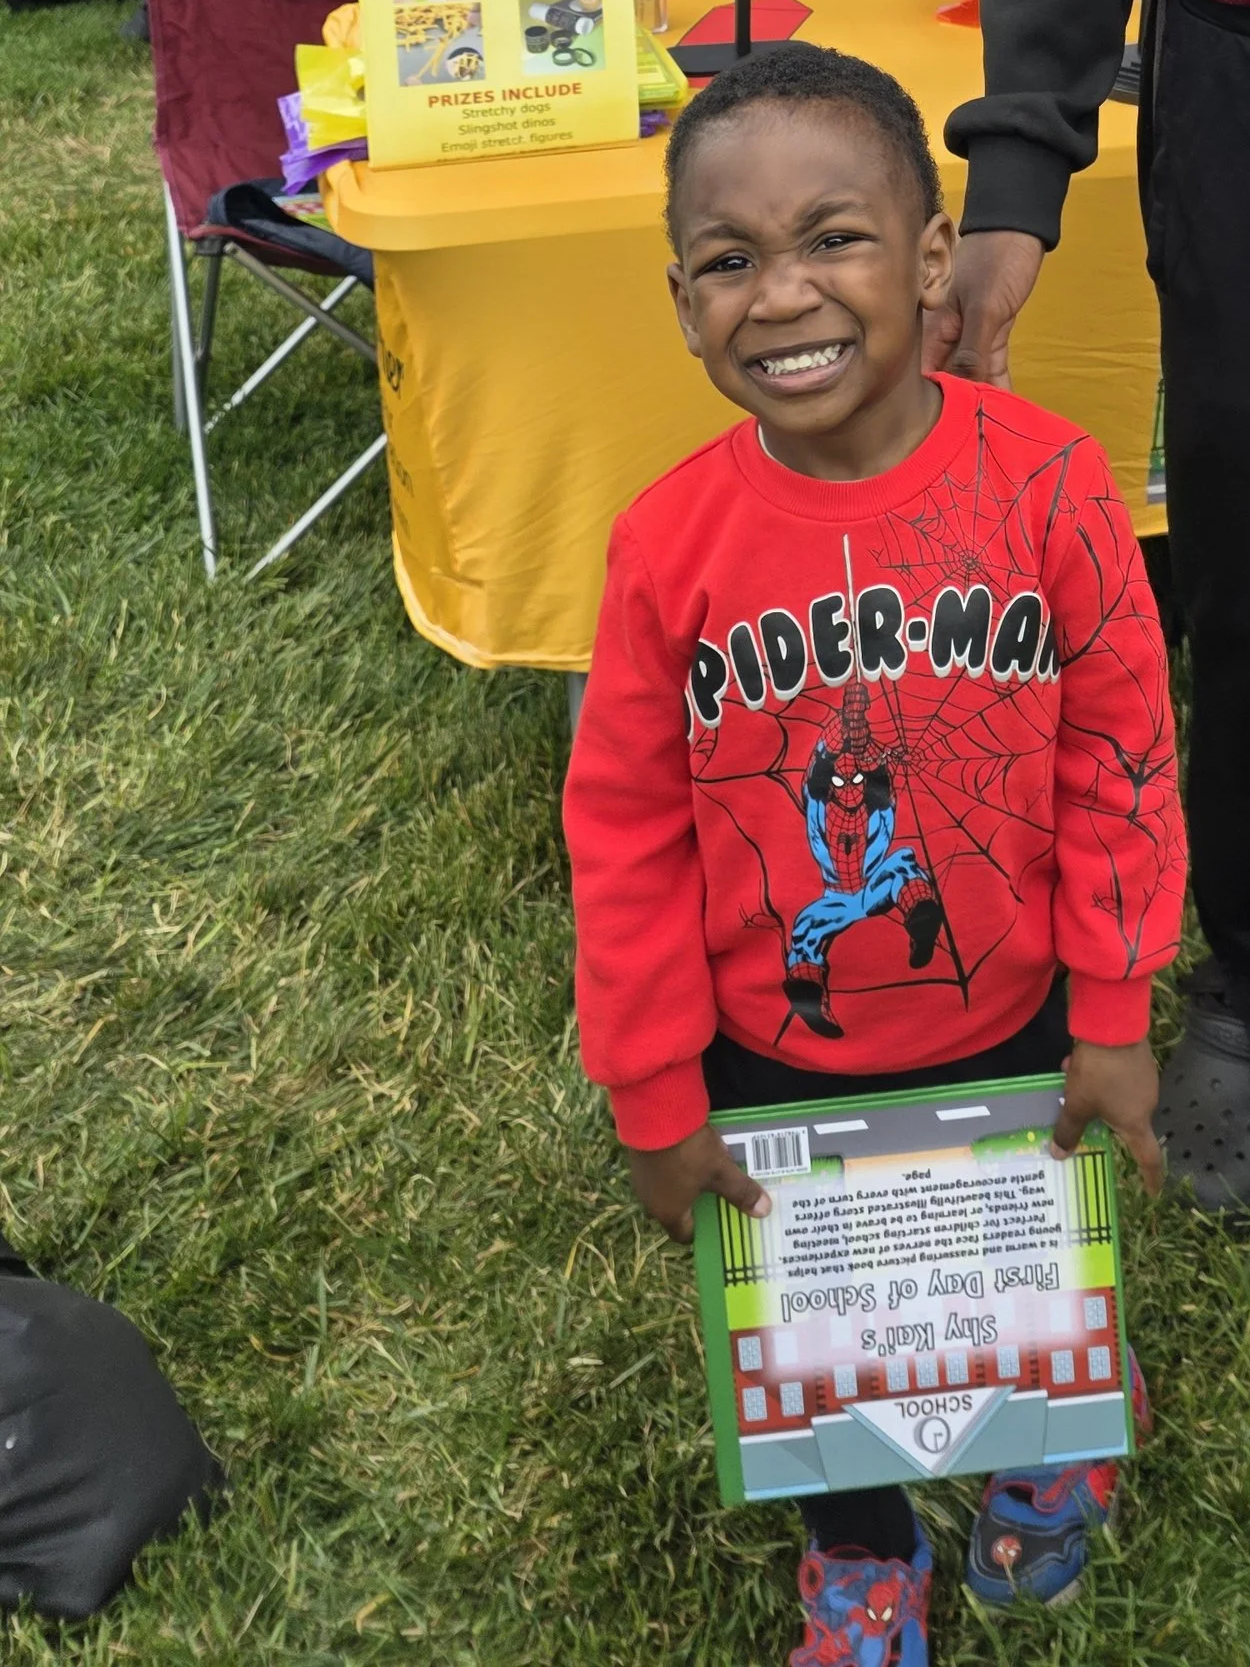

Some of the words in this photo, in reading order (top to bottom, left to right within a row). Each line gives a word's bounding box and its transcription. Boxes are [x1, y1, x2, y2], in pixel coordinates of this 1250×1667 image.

[427, 90, 496, 109] PRIZES
[502, 82, 583, 102] INCLUDE
[461, 104, 518, 121] Stretchy
[520, 101, 552, 116] dogs
[457, 118, 520, 137] Slingshot
[522, 115, 556, 129] dinos
[440, 137, 478, 155] Emoji
[529, 129, 574, 145] figures
[683, 583, 1061, 741] PIDER-MA
[902, 1168, 931, 1181] page.
[1010, 1170, 1045, 1185] gentle
[920, 1177, 1007, 1193] encouragement
[1019, 1185, 1045, 1195] way.
[829, 1194, 853, 1203] turn
[856, 1190, 888, 1200] every
[892, 1187, 917, 1198] with
[994, 1190, 1016, 1200] This
[792, 1199, 811, 1209] the
[814, 1198, 826, 1208] of
[930, 1192, 991, 1207] beautifully
[1032, 1199, 1054, 1207] new
[833, 1206, 864, 1217] story
[868, 1199, 927, 1215] illustrated
[970, 1207, 983, 1215] or
[985, 1202, 1028, 1214] friends,
[795, 1211, 830, 1221] offers
[890, 1215, 903, 1224] be
[906, 1214, 918, 1222] to
[921, 1208, 967, 1221] learning
[1003, 1213, 1045, 1226] Perfect
[842, 1222, 852, 1231] in
[856, 1217, 887, 1228] brave
[934, 1221, 980, 1233] children
[983, 1219, 1000, 1228] for
[785, 1227, 808, 1236] own
[811, 1224, 839, 1234] their
[883, 1226, 931, 1239] starting
[983, 1229, 1026, 1241] readers
[1029, 1223, 1062, 1235] young
[793, 1238, 839, 1250] meeting
[841, 1232, 880, 1246] school,
[934, 1238, 953, 1247] the
[956, 1234, 979, 1244] face
[1049, 1240, 1058, 1248] is
[852, 1247, 875, 1255] new
[878, 1245, 890, 1255] of
[893, 1240, 931, 1251] nerves
[982, 1246, 1002, 1256] and
[1005, 1242, 1037, 1252] warm
[779, 1249, 850, 1264] experiences.
[877, 1253, 916, 1267] picture
[919, 1248, 979, 1262] reassuring
[788, 1267, 818, 1277] helps
[820, 1264, 845, 1274] that
[848, 1260, 873, 1272] book
[927, 1268, 984, 1299] Day
[994, 1262, 1060, 1293] First
[888, 1278, 918, 1311] of
[780, 1283, 877, 1323] School
[944, 1312, 998, 1347] Shy
[861, 1322, 935, 1357] Kai's
[894, 1394, 972, 1418] SCHOOL
